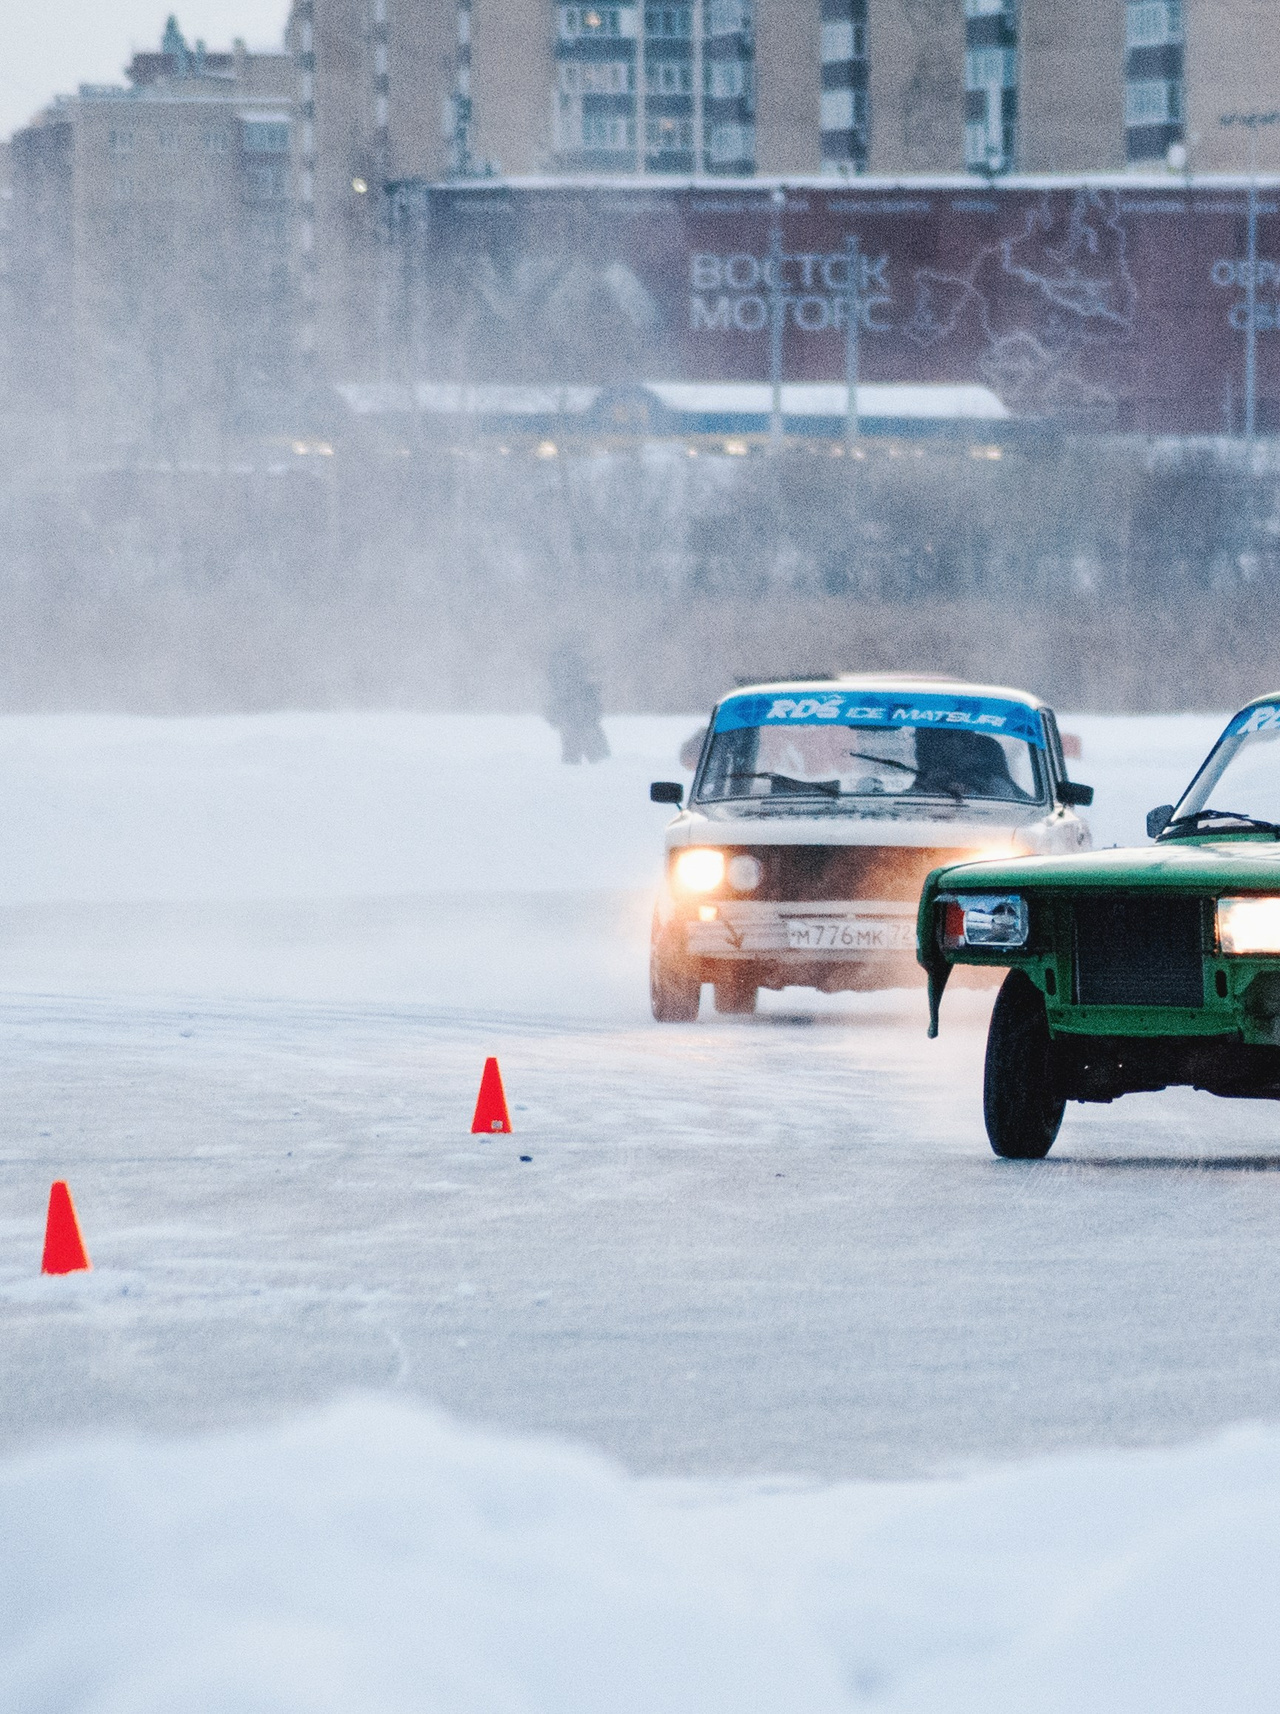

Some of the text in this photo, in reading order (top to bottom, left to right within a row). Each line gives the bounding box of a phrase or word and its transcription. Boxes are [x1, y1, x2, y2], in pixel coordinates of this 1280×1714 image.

[689, 252, 890, 290] ВОСТОК
[845, 707, 885, 721] ICE
[891, 707, 1007, 727] MATSURI
